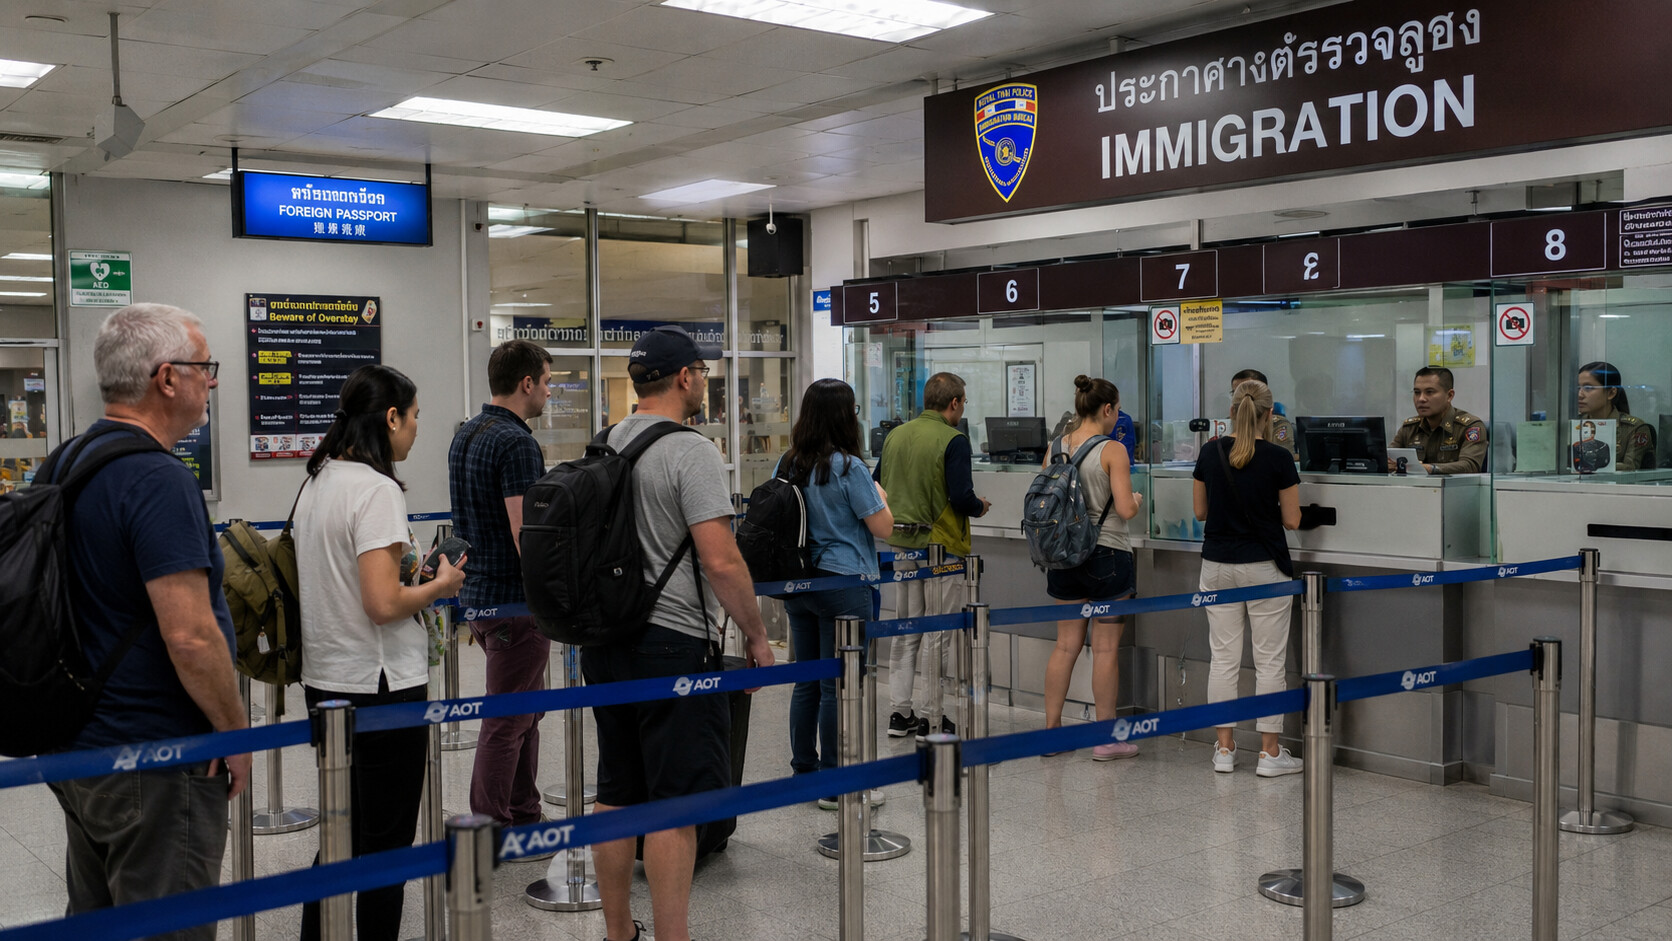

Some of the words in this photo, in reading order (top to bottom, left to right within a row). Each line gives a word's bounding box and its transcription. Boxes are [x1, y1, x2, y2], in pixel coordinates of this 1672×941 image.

[1101, 74, 1475, 179] IMMIGRATION
[279, 205, 332, 219] FOREIGN
[336, 208, 398, 222] PASSPORT
[1544, 228, 1567, 261] 8
[1175, 263, 1191, 290] 7
[93, 281, 110, 289] AED
[1005, 279, 1019, 303] 6
[869, 292, 880, 314] 5
[269, 312, 304, 322] Beware
[306, 312, 316, 322] of
[795, 581, 812, 590] AOT
[1421, 575, 1434, 584] AOT
[1202, 594, 1217, 604] AOT
[478, 608, 498, 617] AOT
[1093, 605, 1111, 614] AOT
[693, 677, 721, 691] AOT
[1416, 670, 1437, 684] AOT
[449, 702, 483, 717] AOT
[1131, 717, 1160, 735] AOT
[142, 744, 185, 764] AOT
[527, 824, 575, 850] AOT
